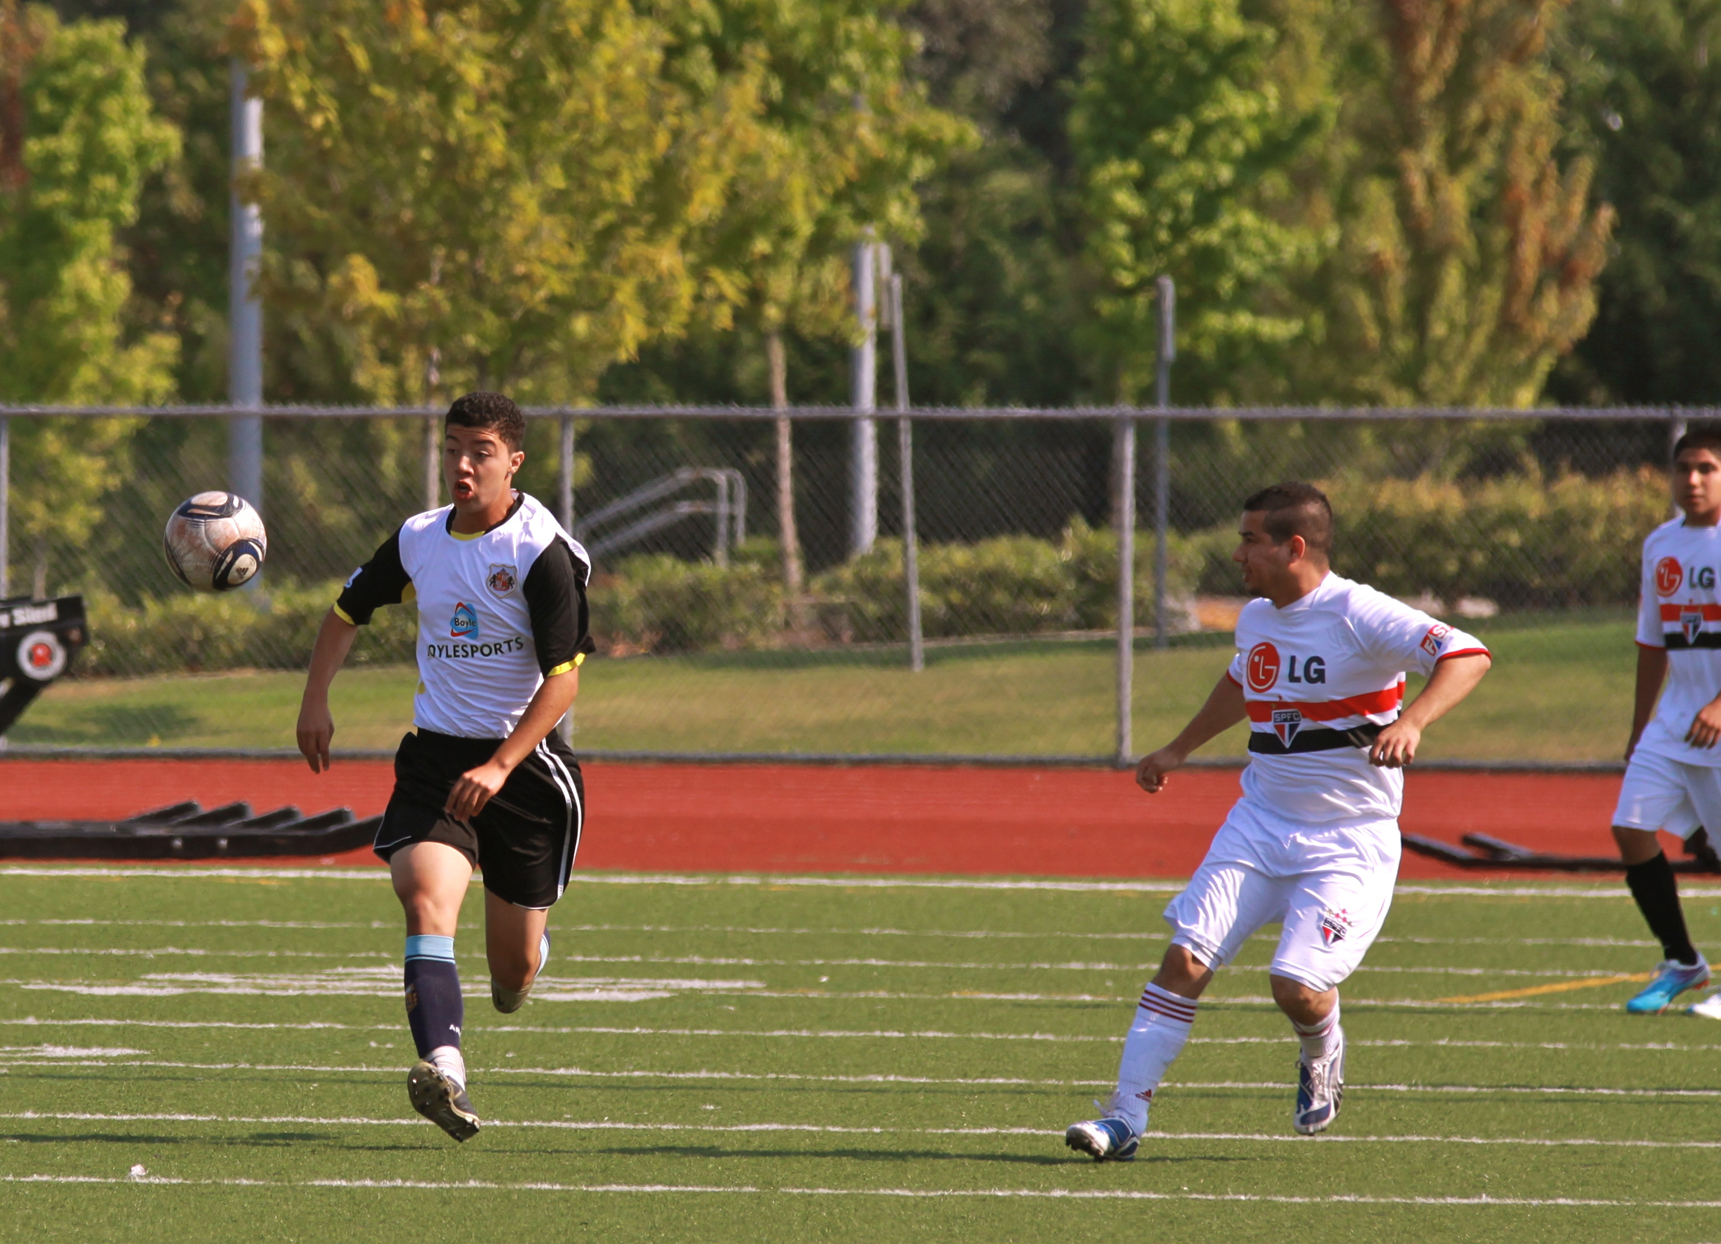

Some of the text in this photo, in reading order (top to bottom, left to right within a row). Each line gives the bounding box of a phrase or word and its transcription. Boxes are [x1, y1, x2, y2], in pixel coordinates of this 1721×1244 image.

[1689, 567, 1715, 590] LG
[454, 617, 476, 629] Boyle
[1288, 655, 1326, 684] LG
[1274, 712, 1300, 722] SPFC
